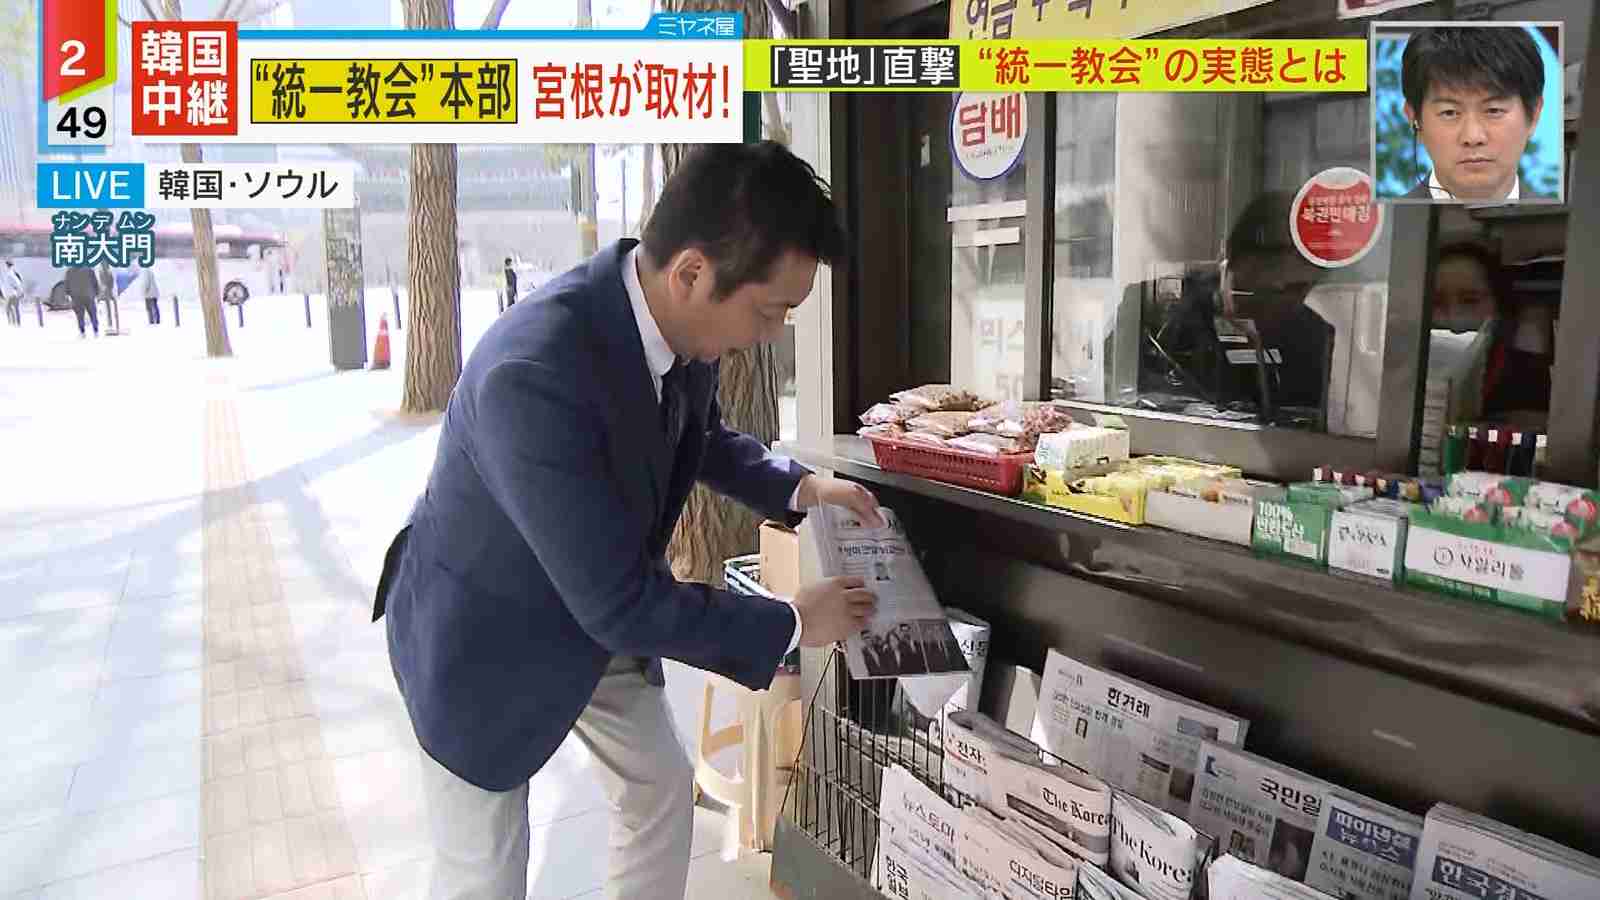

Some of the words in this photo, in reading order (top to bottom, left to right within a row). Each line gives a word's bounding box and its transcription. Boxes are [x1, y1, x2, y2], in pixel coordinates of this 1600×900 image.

[960, 93, 1021, 147] 담배
[957, 740, 986, 766] 전자
[1043, 787, 1069, 815] The
